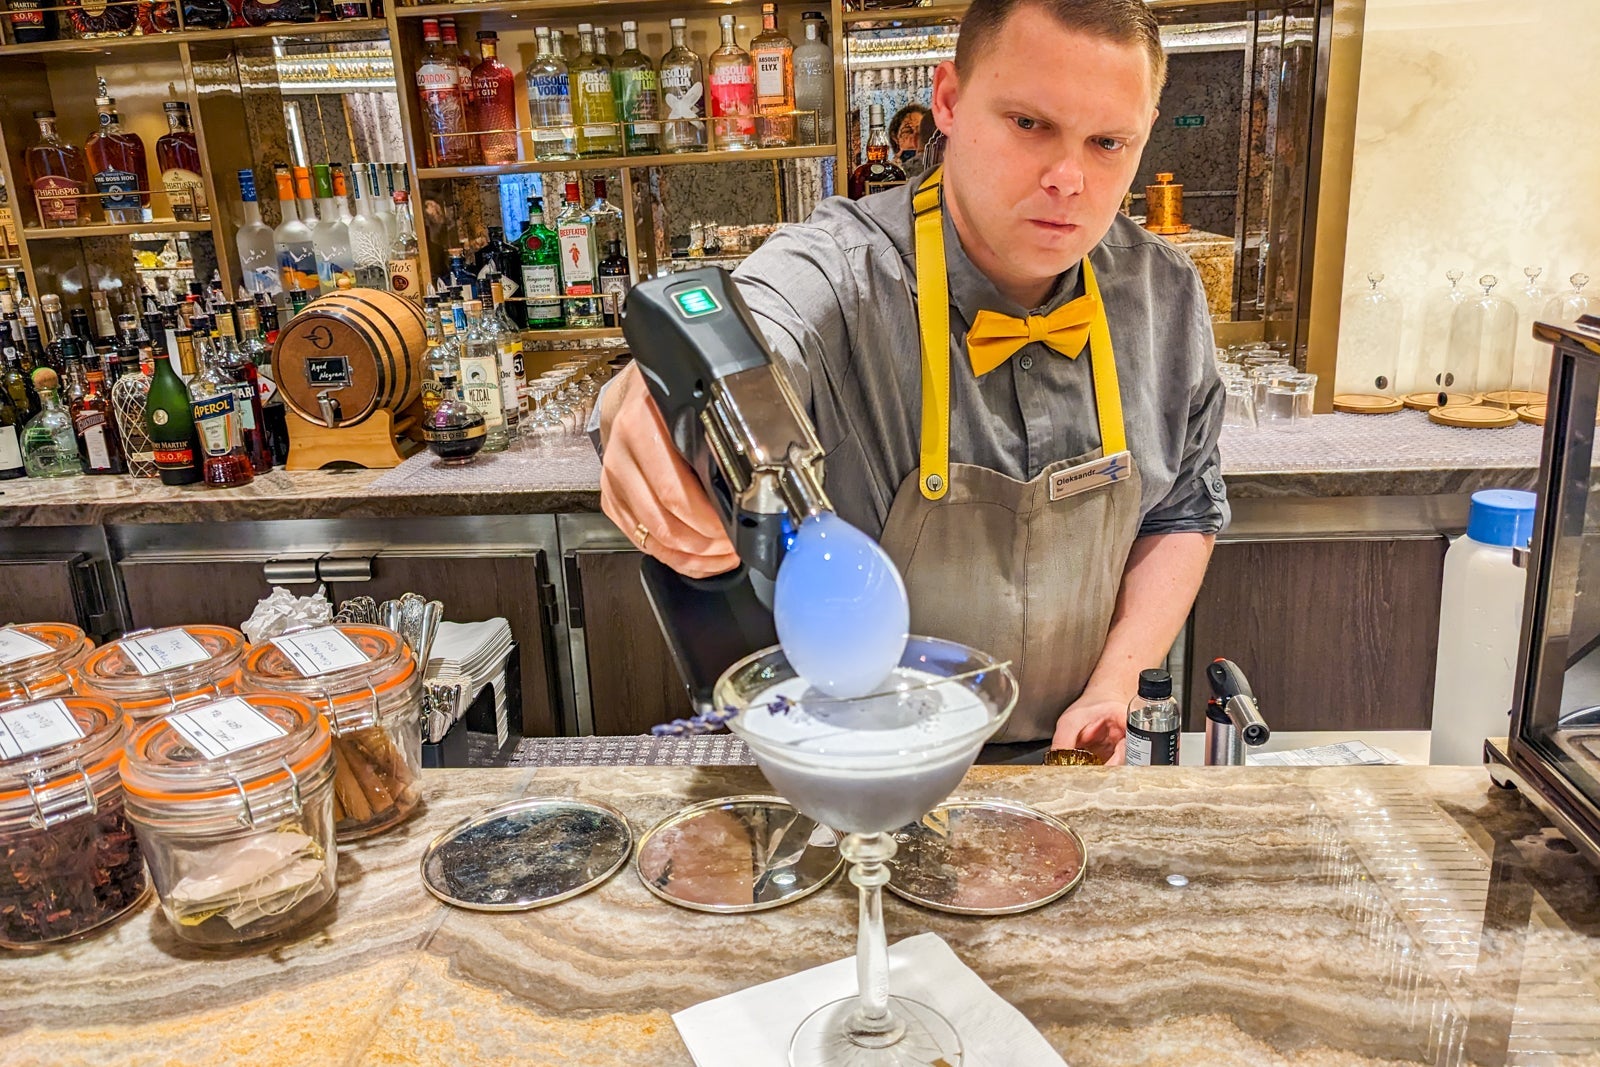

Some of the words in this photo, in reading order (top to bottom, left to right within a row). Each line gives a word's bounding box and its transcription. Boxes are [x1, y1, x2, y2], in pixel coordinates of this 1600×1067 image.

[533, 75, 569, 87] ABSOLUT
[538, 85, 568, 96] VODKA
[560, 228, 587, 237] BEEFEATER
[514, 358, 524, 373] 51
[469, 388, 491, 401] MEZCAL
[194, 400, 230, 418] APEROL
[1056, 470, 1096, 486] Oleksandr
